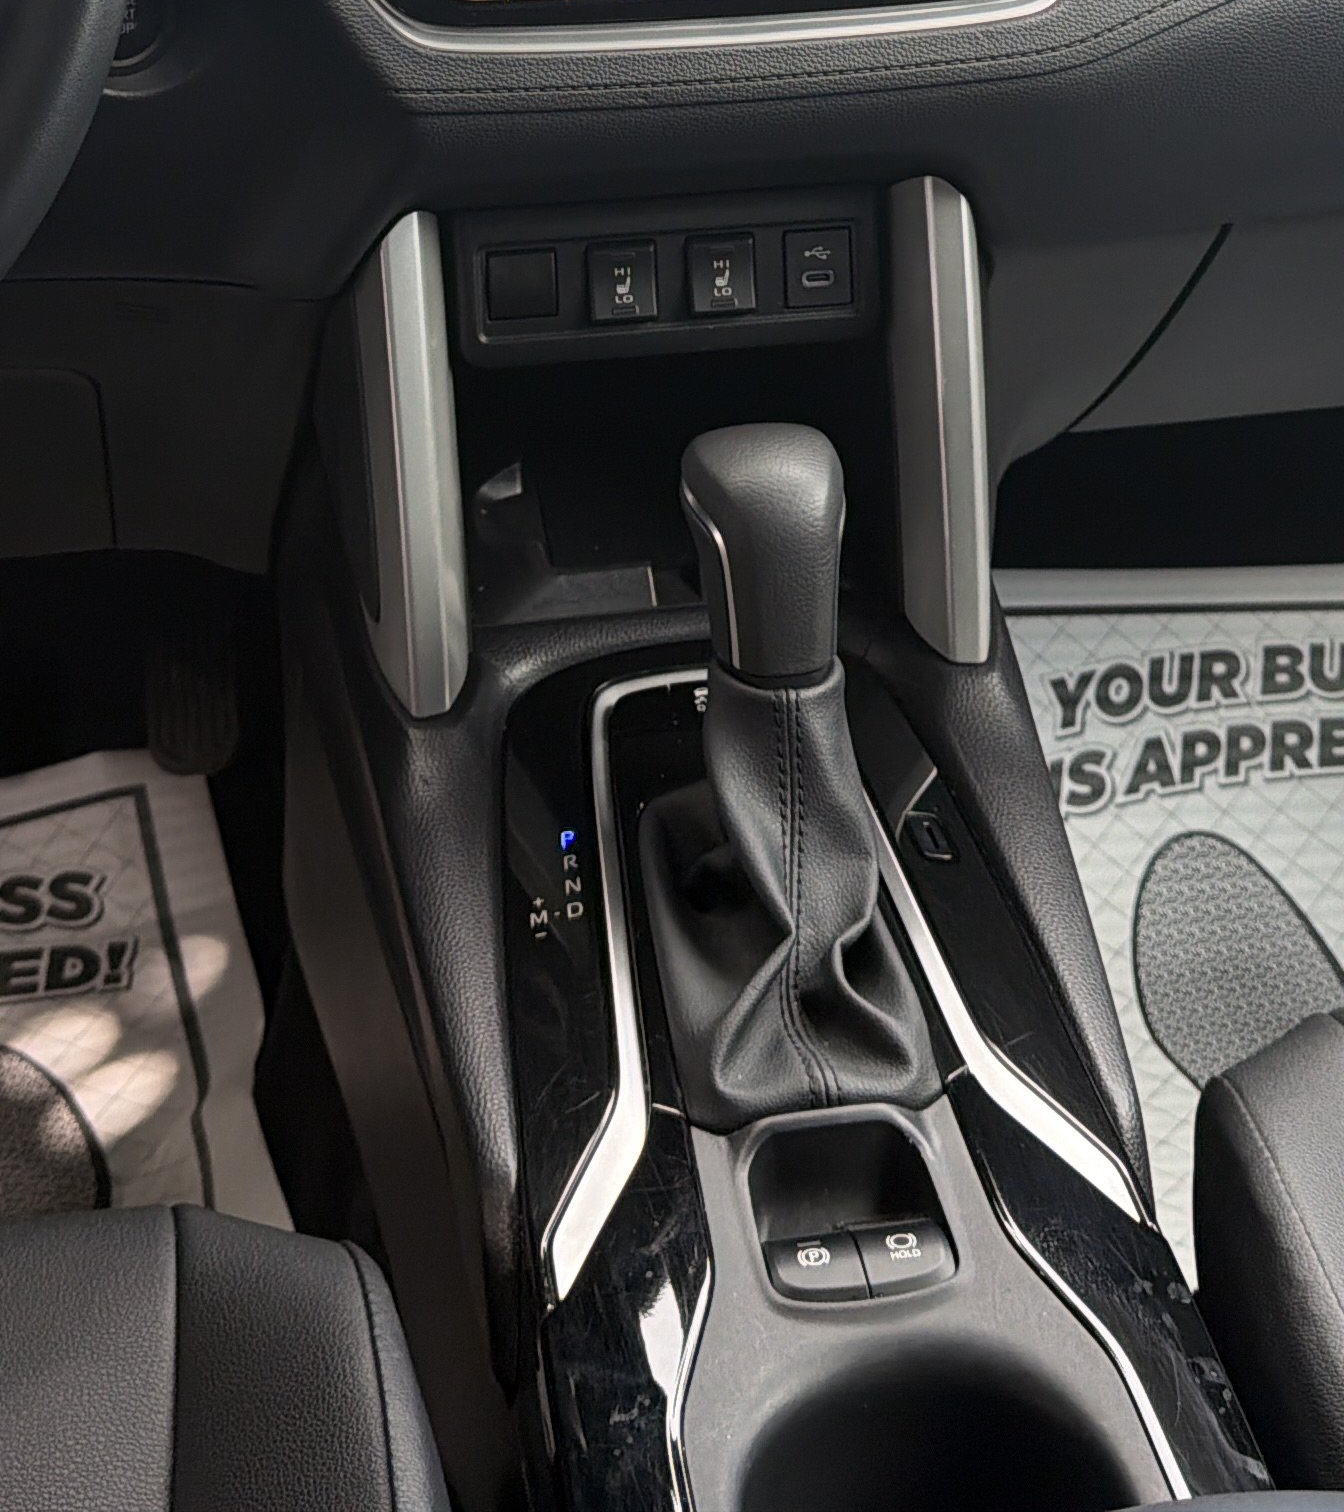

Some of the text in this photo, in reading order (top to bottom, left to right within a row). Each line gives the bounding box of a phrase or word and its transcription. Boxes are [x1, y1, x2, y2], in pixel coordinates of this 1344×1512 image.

[713, 259, 730, 269] HI
[614, 267, 631, 277] HI
[713, 287, 732, 297] LO
[615, 294, 634, 304] LO
[1051, 648, 1246, 733] YOUR
[560, 830, 575, 851] P
[563, 854, 579, 872] R
[564, 876, 582, 896] N
[890, 1248, 921, 1260] HOLD
